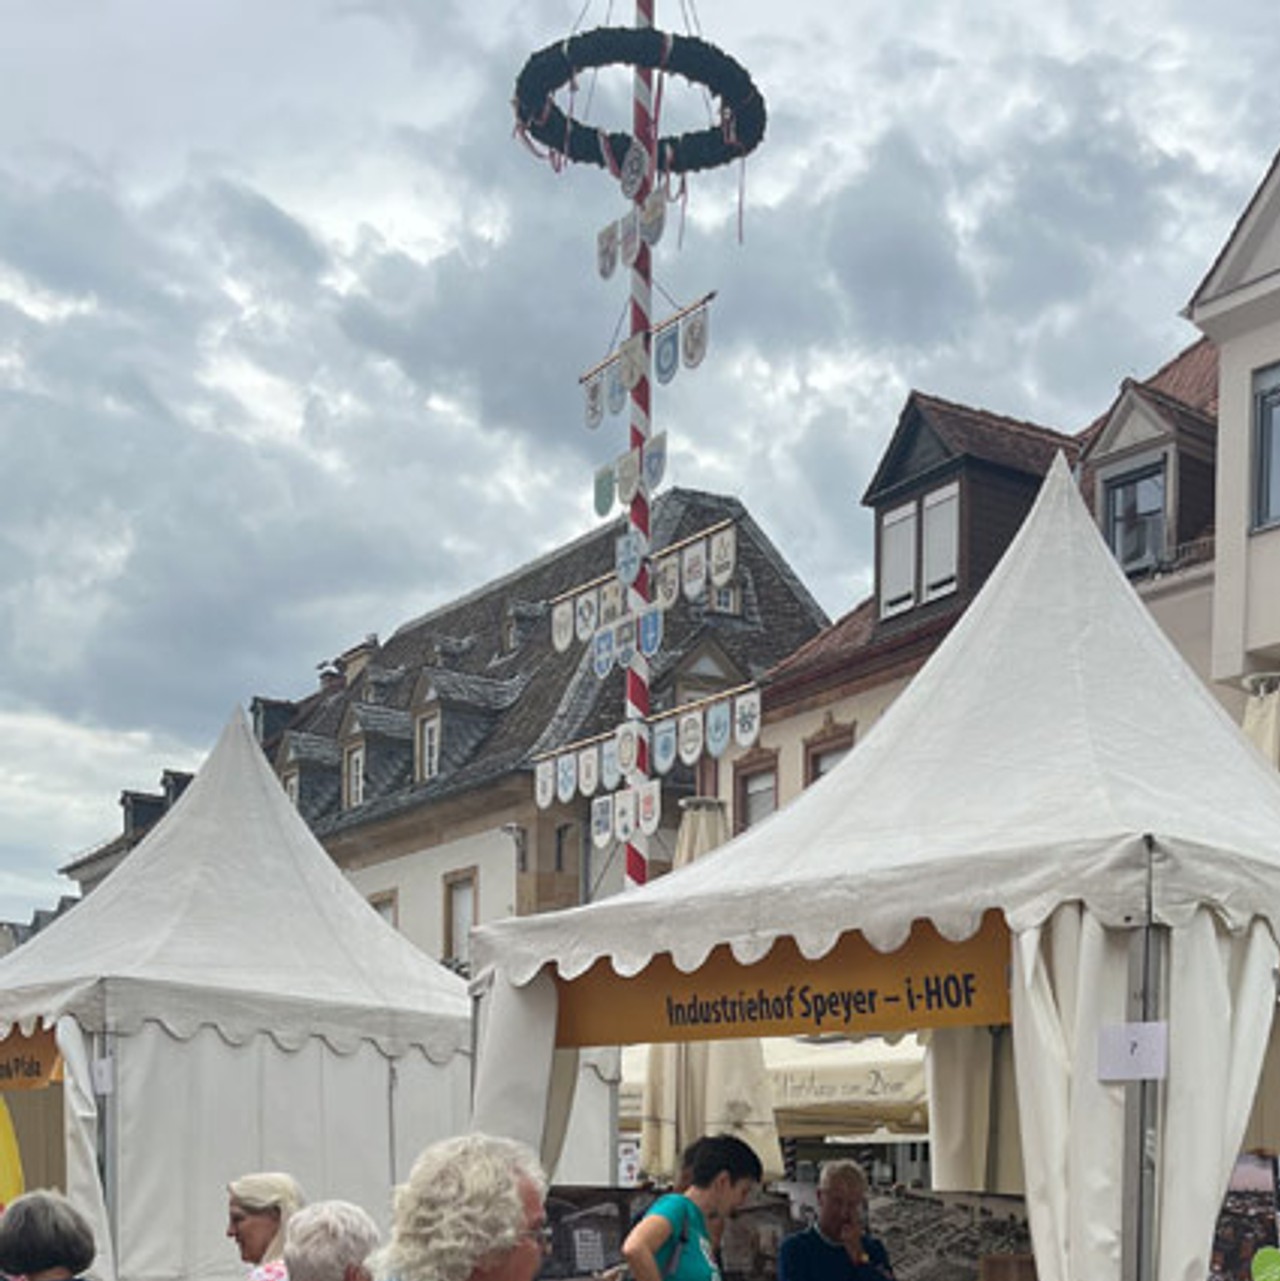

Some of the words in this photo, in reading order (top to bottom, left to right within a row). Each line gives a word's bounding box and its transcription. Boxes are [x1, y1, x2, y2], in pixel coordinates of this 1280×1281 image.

[666, 985, 795, 1026] Industriehof
[800, 985, 878, 1026] Speyer
[905, 973, 976, 1012] i-HOF
